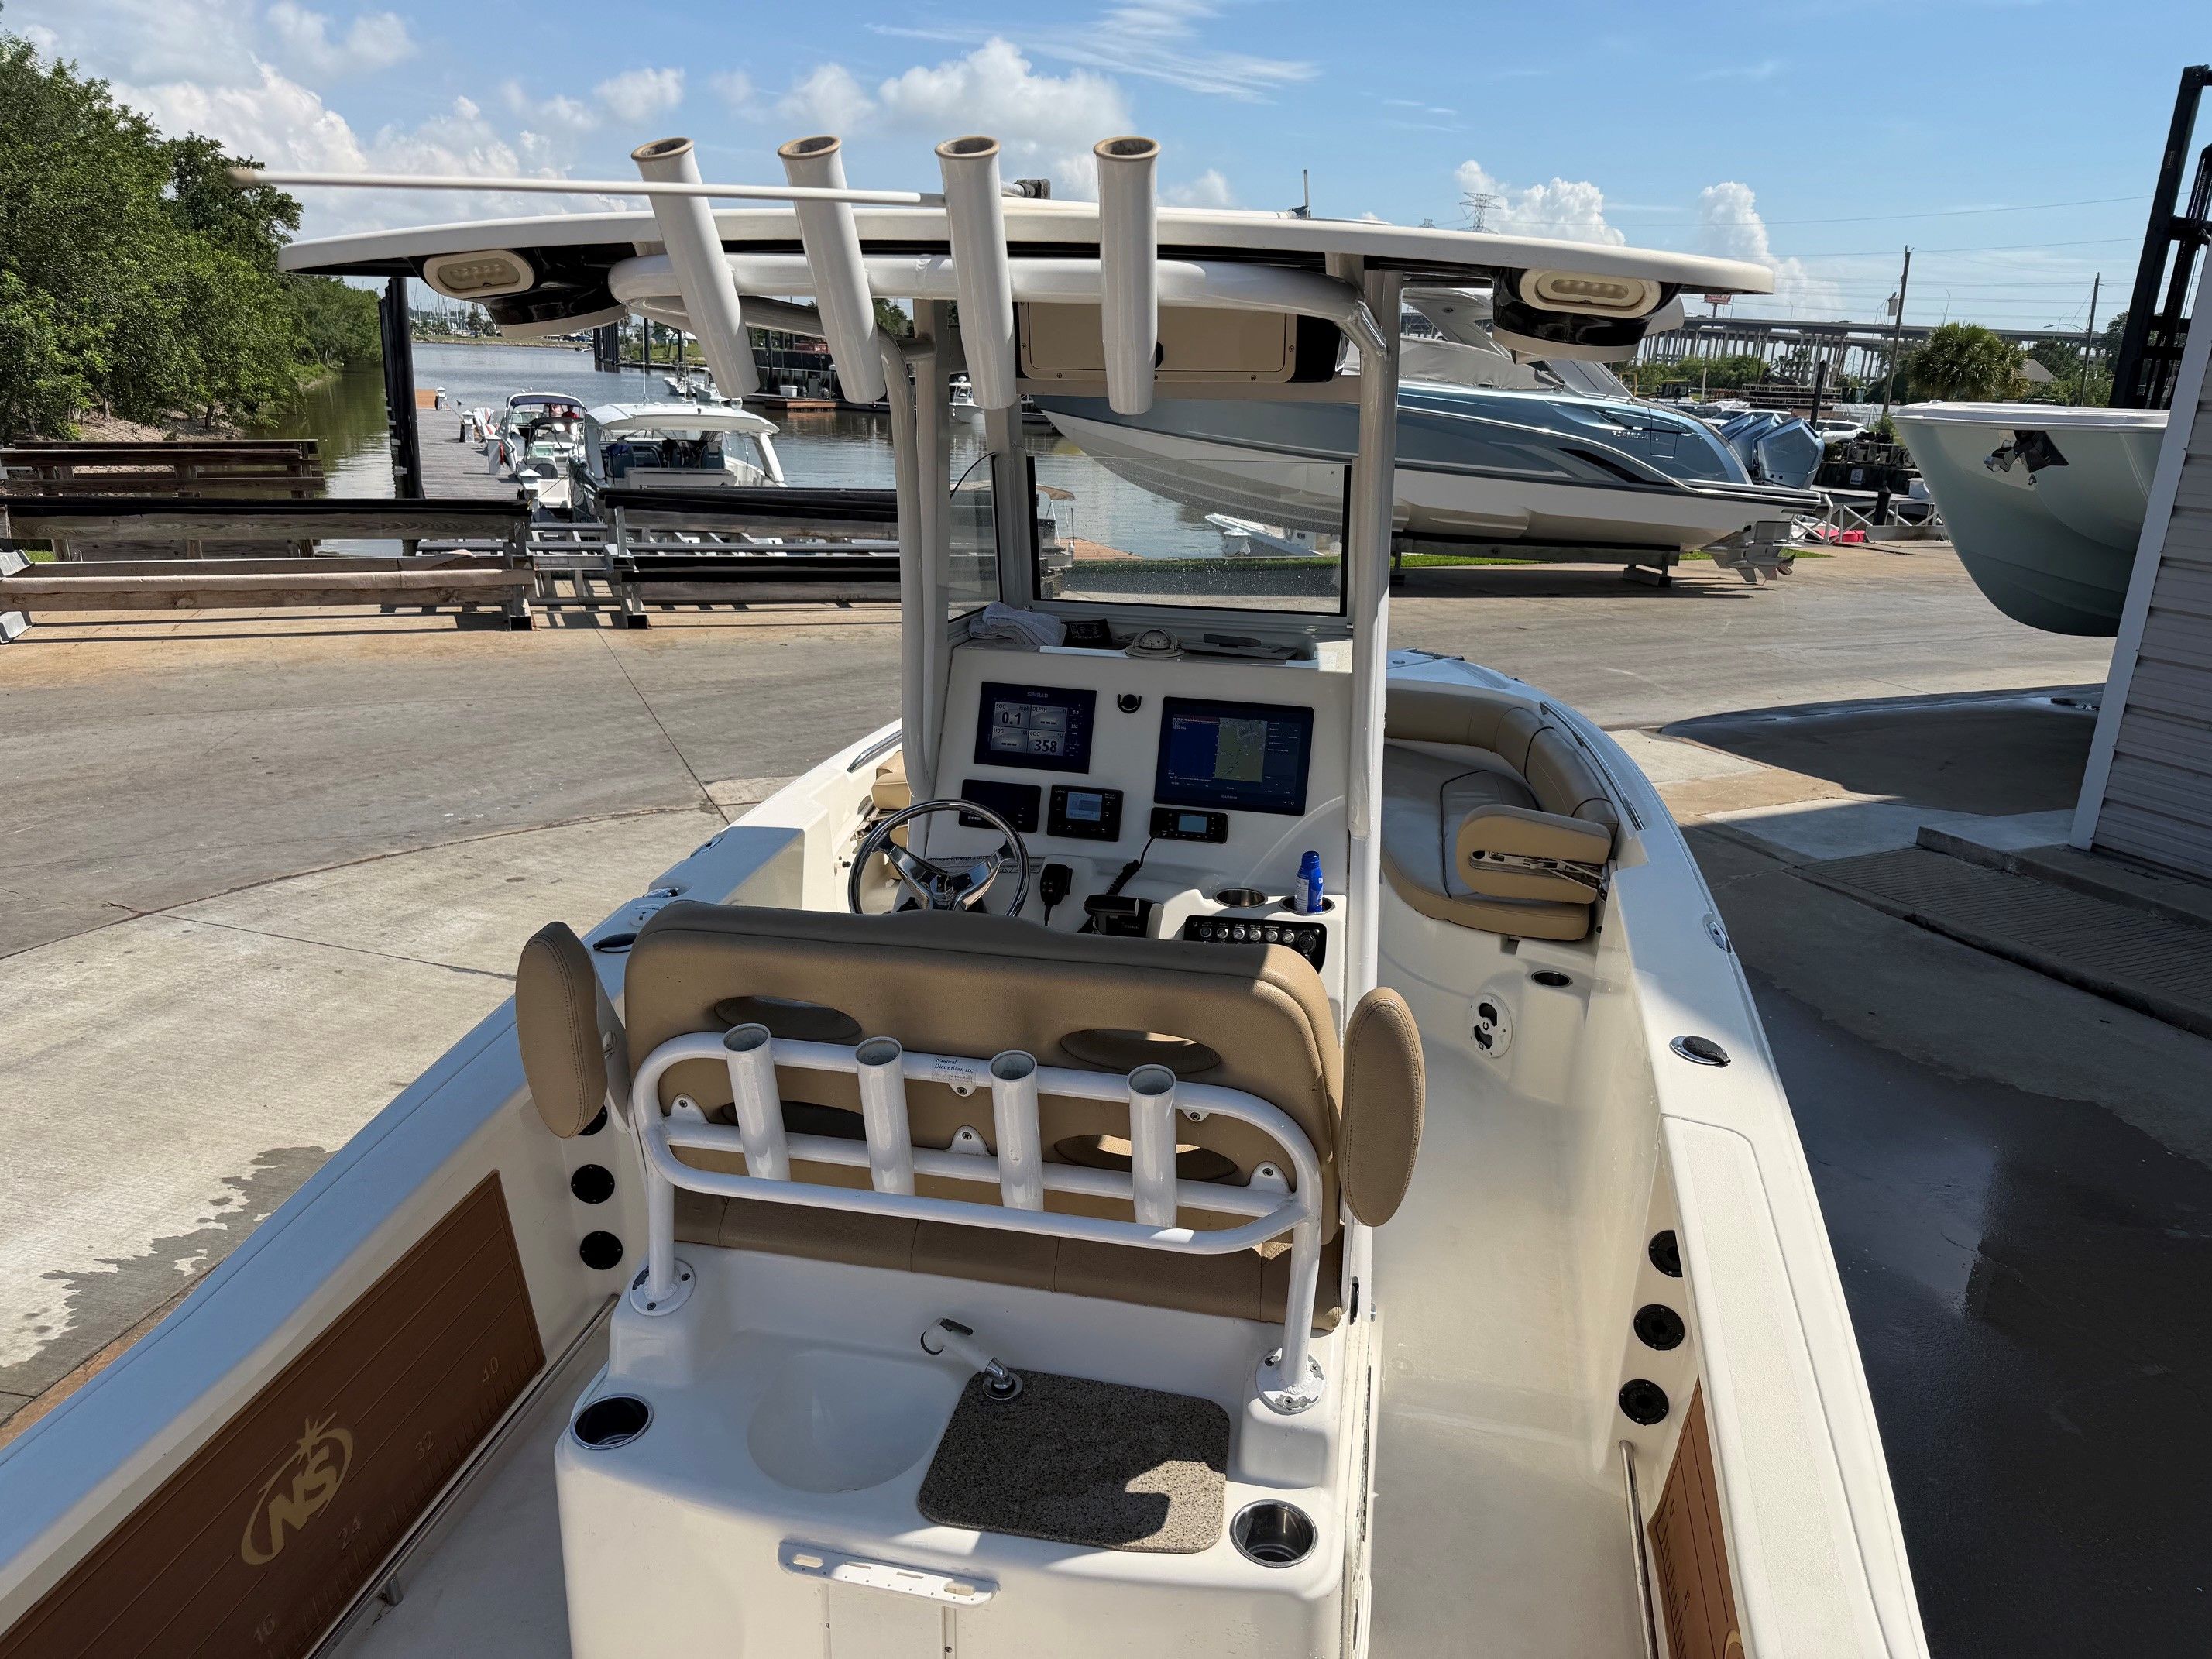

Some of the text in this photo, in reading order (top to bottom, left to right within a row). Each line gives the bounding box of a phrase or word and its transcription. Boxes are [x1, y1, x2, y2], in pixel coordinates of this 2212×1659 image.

[1001, 711, 1022, 725] 0.1
[1034, 739, 1057, 753] 358
[483, 1356, 500, 1384] 40
[414, 1431, 435, 1461] 32
[338, 1516, 364, 1551] 24
[253, 1613, 276, 1646] 16
